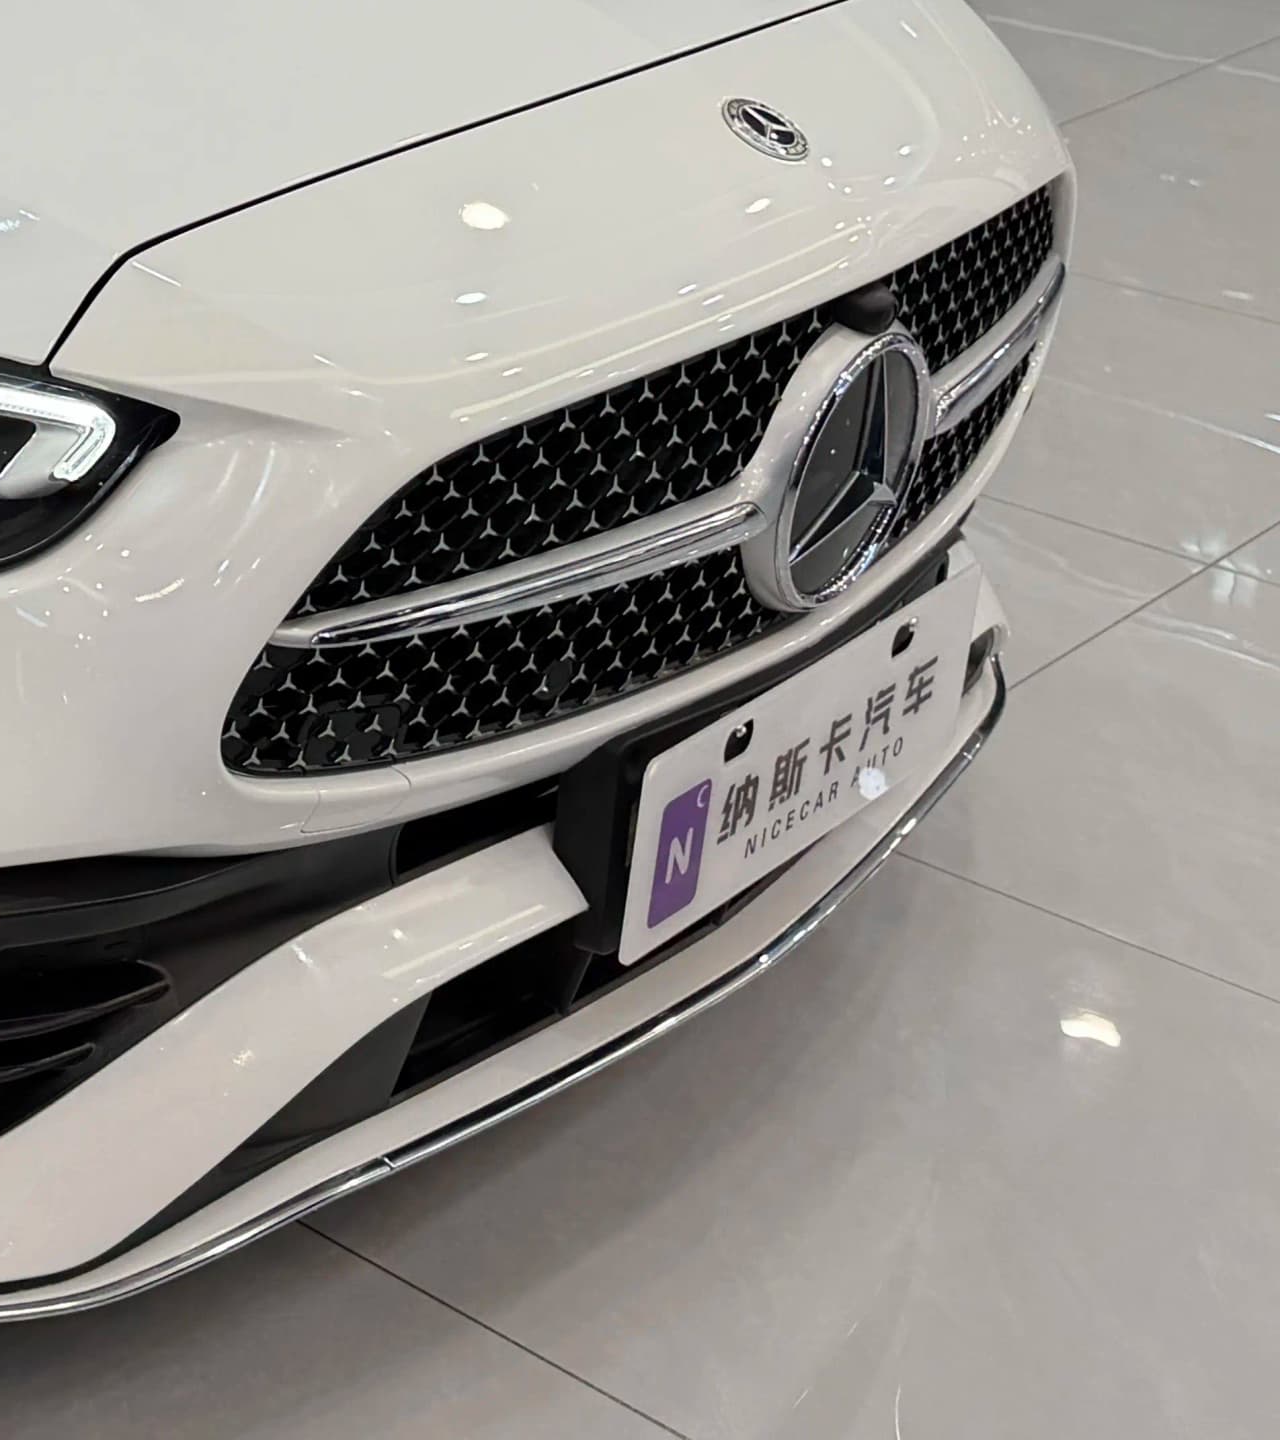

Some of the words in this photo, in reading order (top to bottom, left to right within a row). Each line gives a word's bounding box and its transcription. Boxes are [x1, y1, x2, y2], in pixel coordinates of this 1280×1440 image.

[716, 655, 939, 844] 纳斯卡汽车
[664, 826, 694, 885] N
[743, 780, 840, 860] NICECAR
